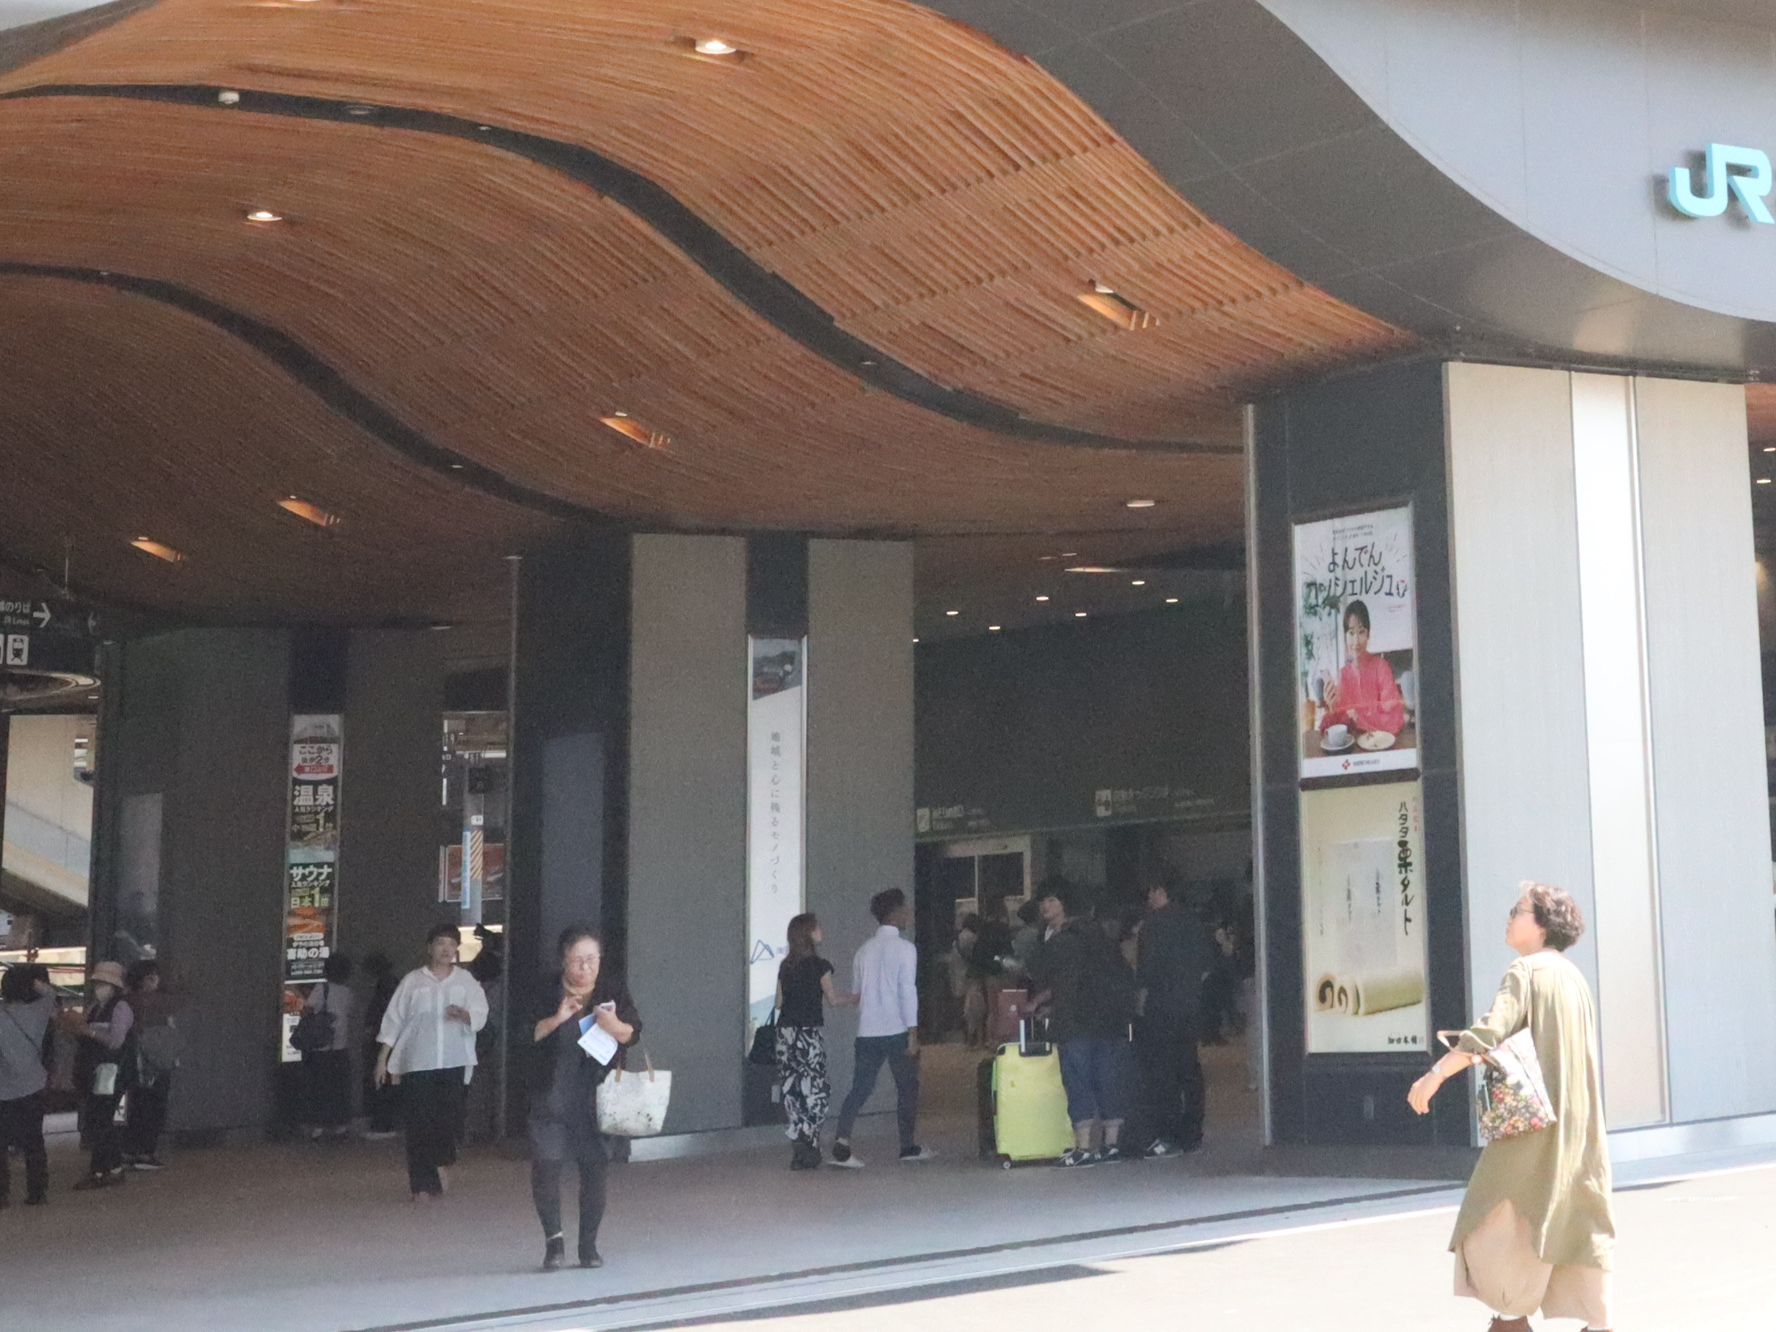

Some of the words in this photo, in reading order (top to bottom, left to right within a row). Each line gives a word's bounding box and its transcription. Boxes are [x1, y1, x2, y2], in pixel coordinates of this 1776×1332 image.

[1668, 142, 1776, 225] JR
[1327, 541, 1383, 574] よんでん
[293, 784, 335, 806] 温泉
[289, 864, 333, 882] サウナ
